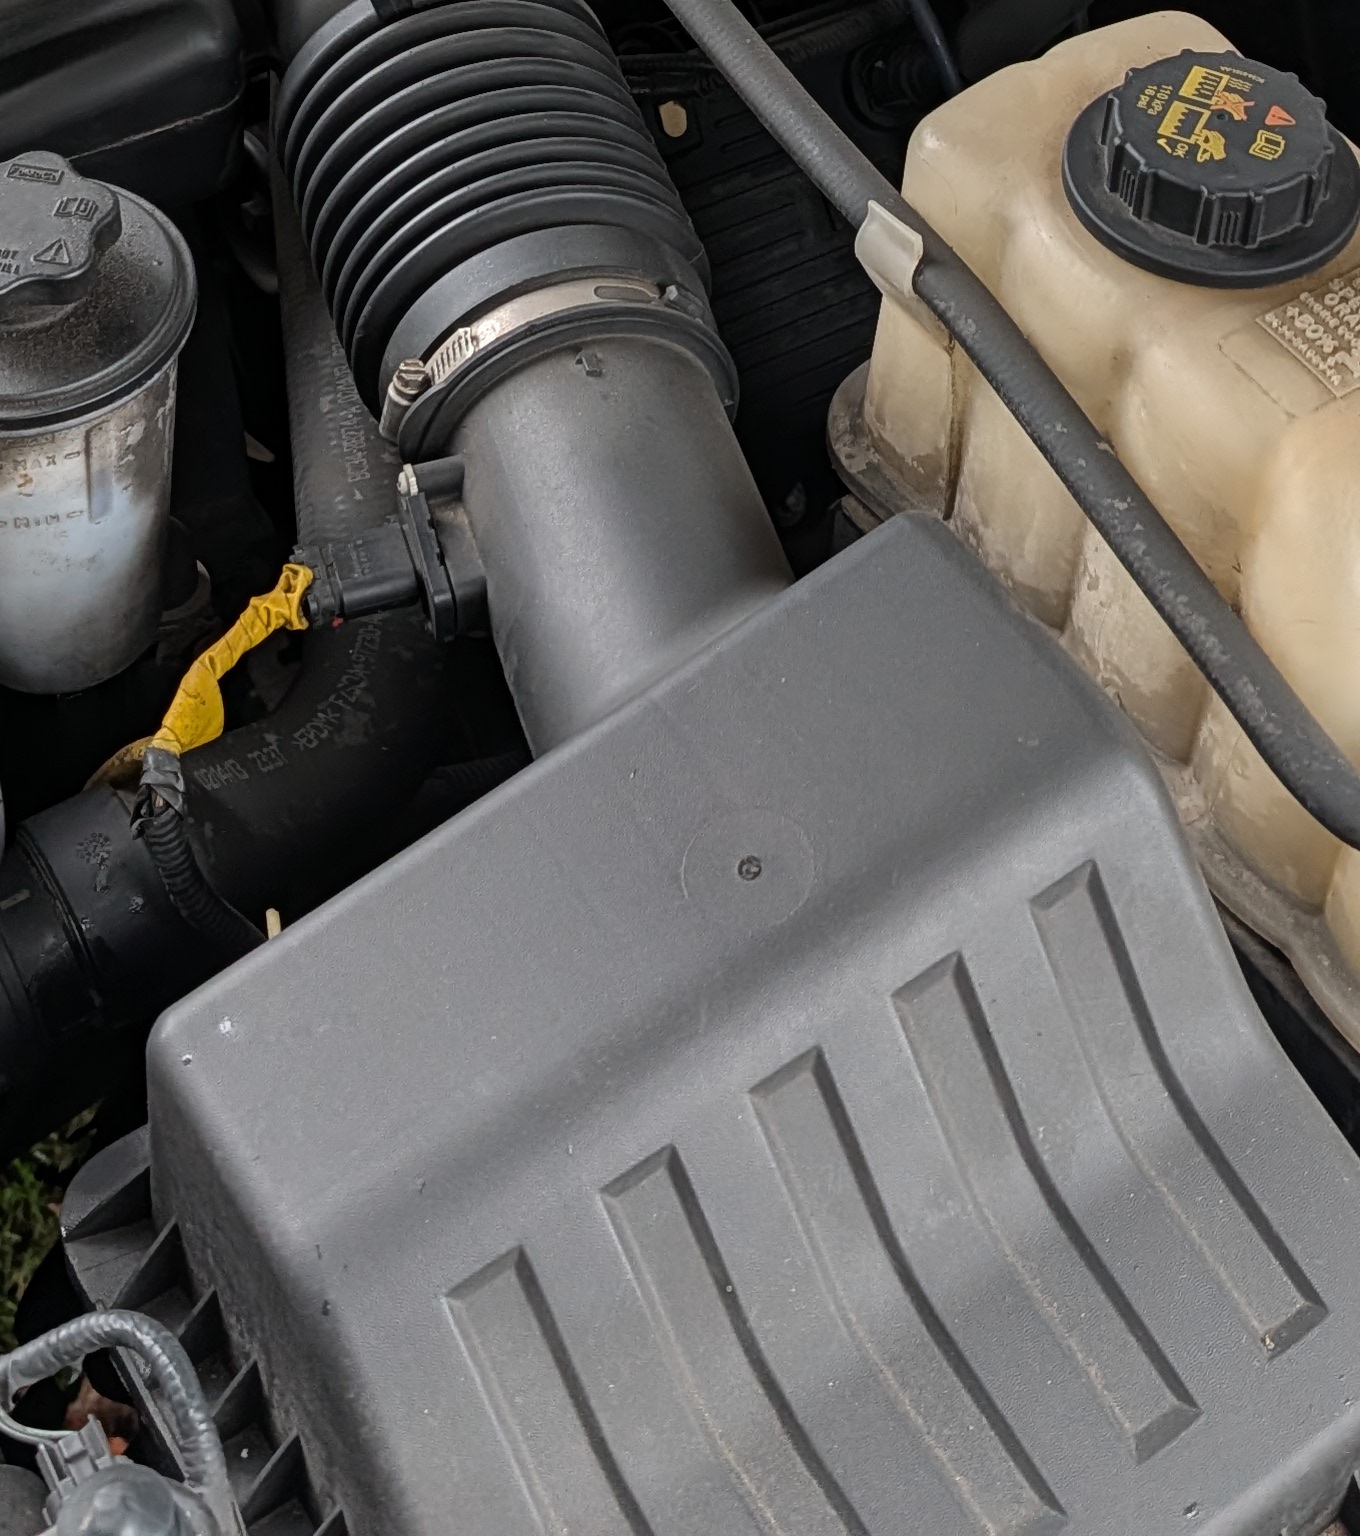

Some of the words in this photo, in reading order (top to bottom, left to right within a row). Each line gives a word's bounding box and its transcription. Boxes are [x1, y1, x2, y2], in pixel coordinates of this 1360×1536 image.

[1144, 84, 1158, 97] 16
[1156, 84, 1174, 100] 110
[1172, 142, 1189, 159] OK
[12, 454, 57, 471] MAX
[13, 513, 60, 529] MIN
